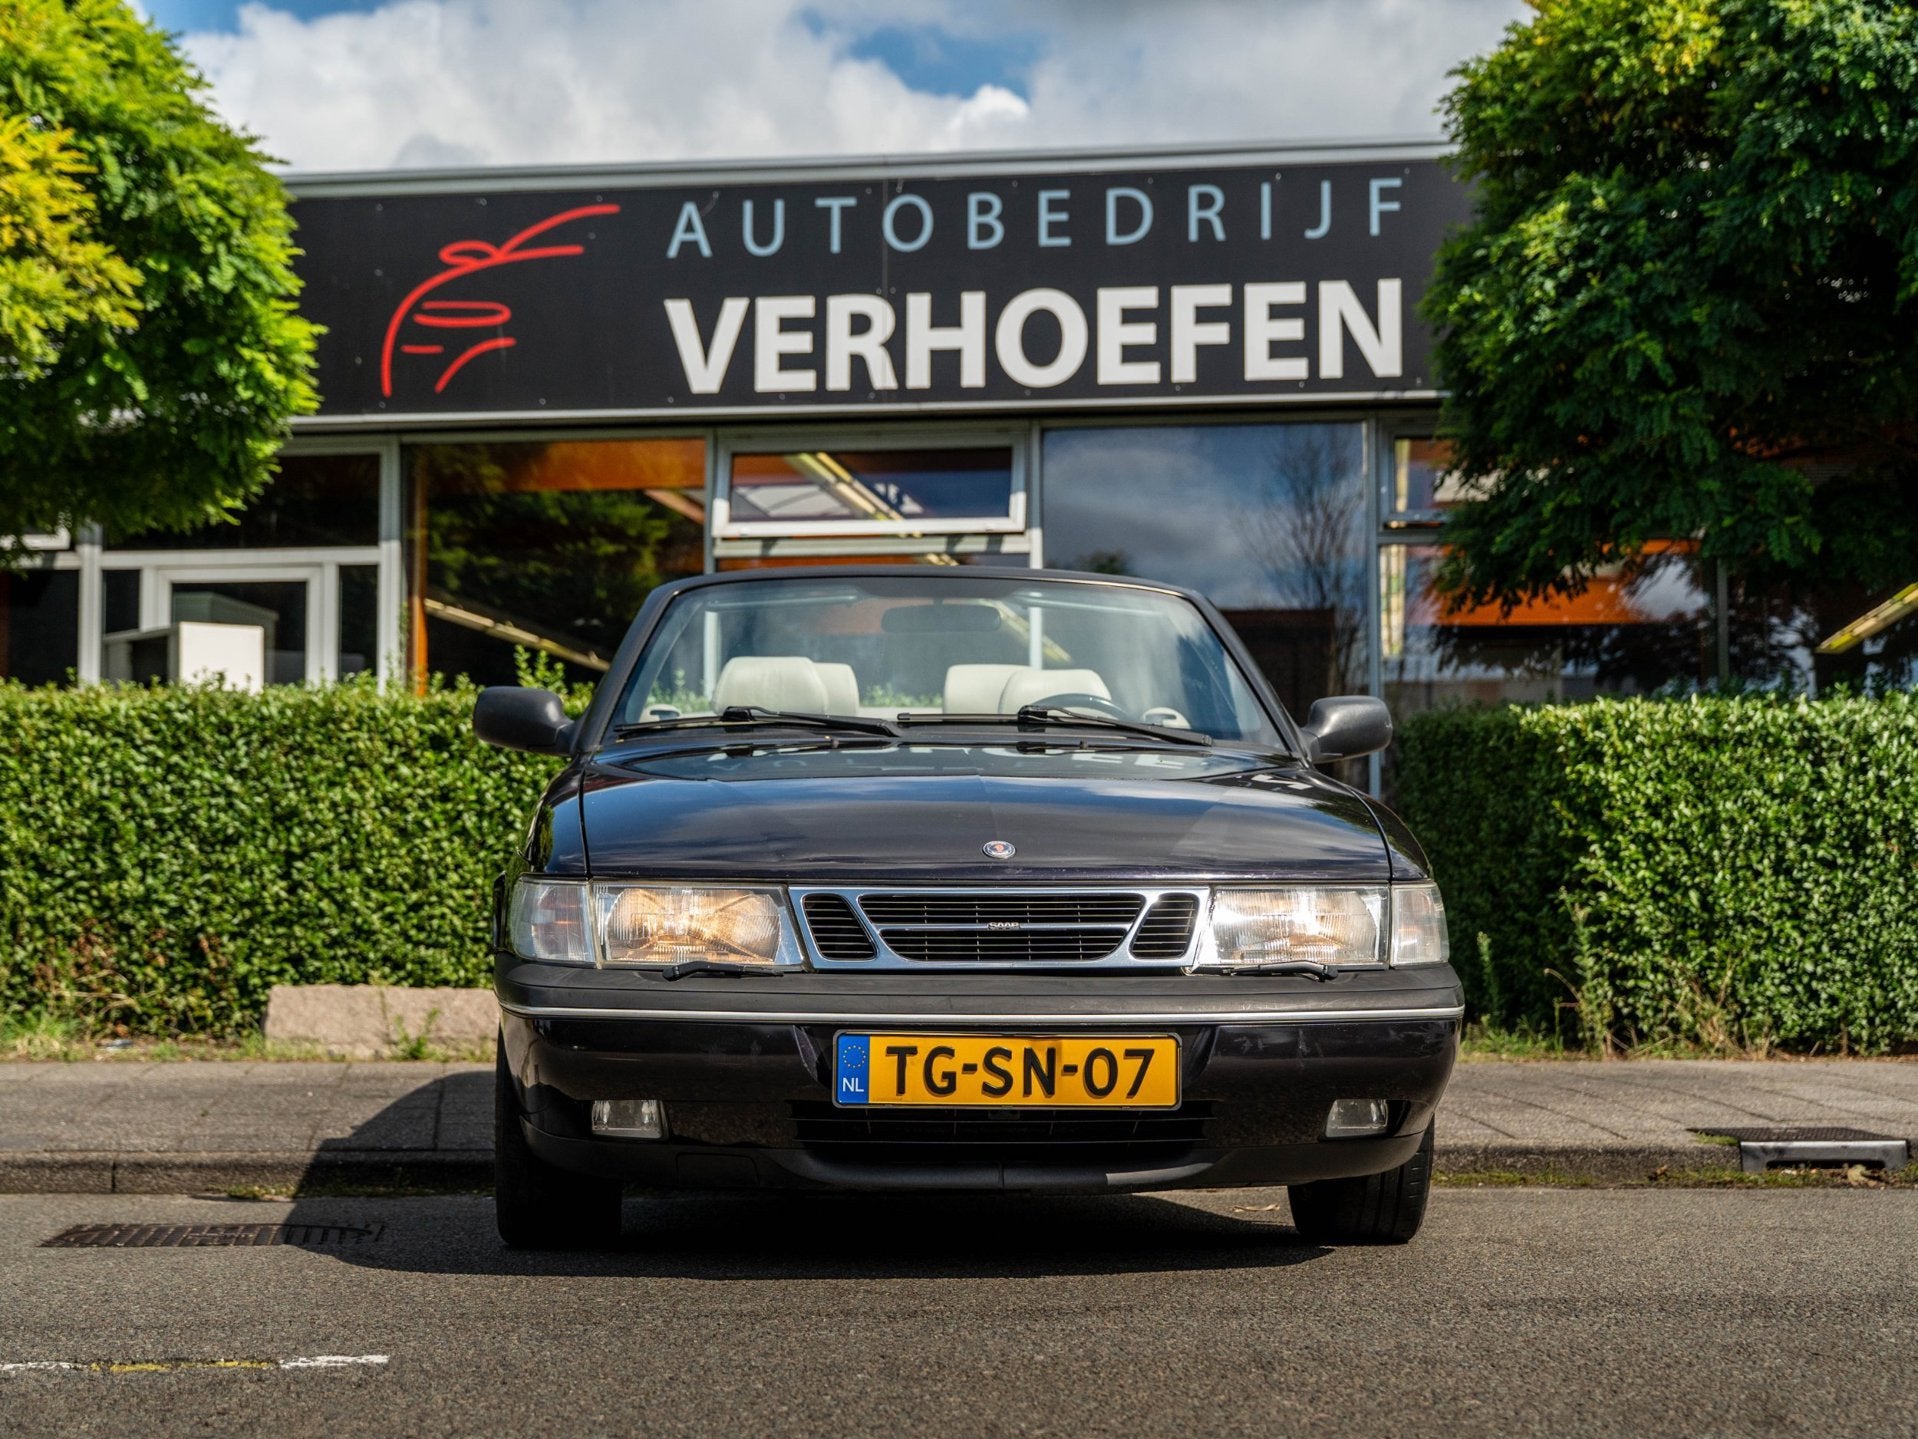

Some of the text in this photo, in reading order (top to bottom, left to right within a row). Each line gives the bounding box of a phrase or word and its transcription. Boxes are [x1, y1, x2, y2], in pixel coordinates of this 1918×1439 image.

[666, 177, 1403, 259] AUTOBEDRIJF
[664, 278, 1402, 394] VERHOEFEN
[842, 1077, 865, 1092] NL
[885, 1045, 1155, 1098] TG-SN-07
